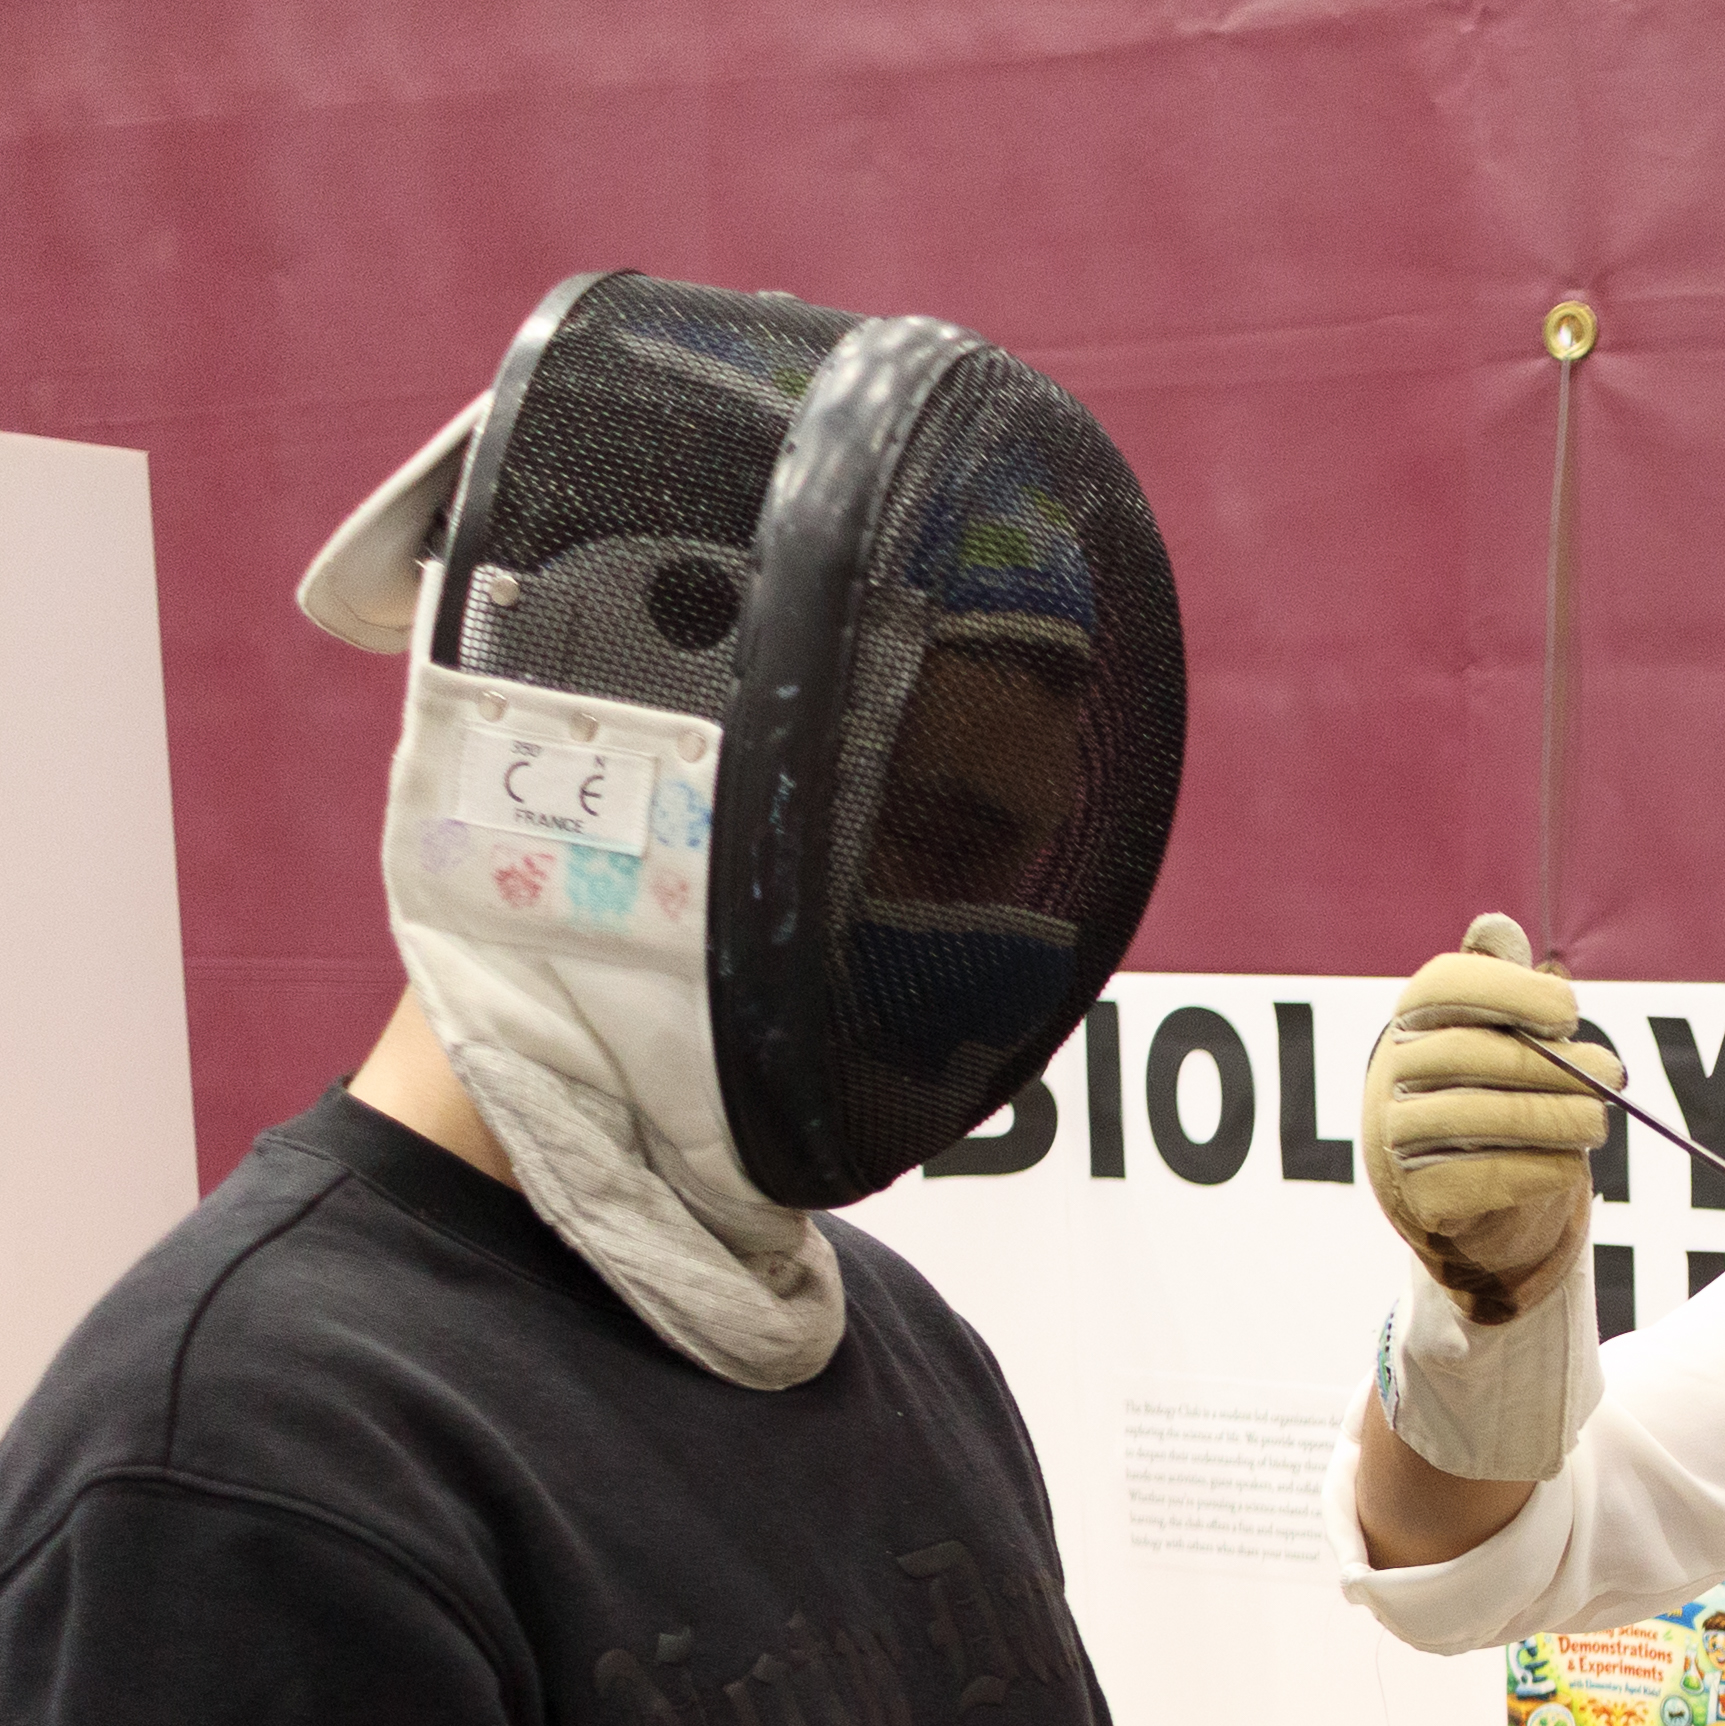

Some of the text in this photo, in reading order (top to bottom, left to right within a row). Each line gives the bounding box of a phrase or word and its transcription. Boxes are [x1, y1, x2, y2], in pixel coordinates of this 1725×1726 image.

[515, 807, 585, 835] FRANCE
[1618, 1623, 1658, 1641] Science
[1558, 1636, 1673, 1664] Demonstrations
[1567, 1657, 1664, 1683] & Experiments
